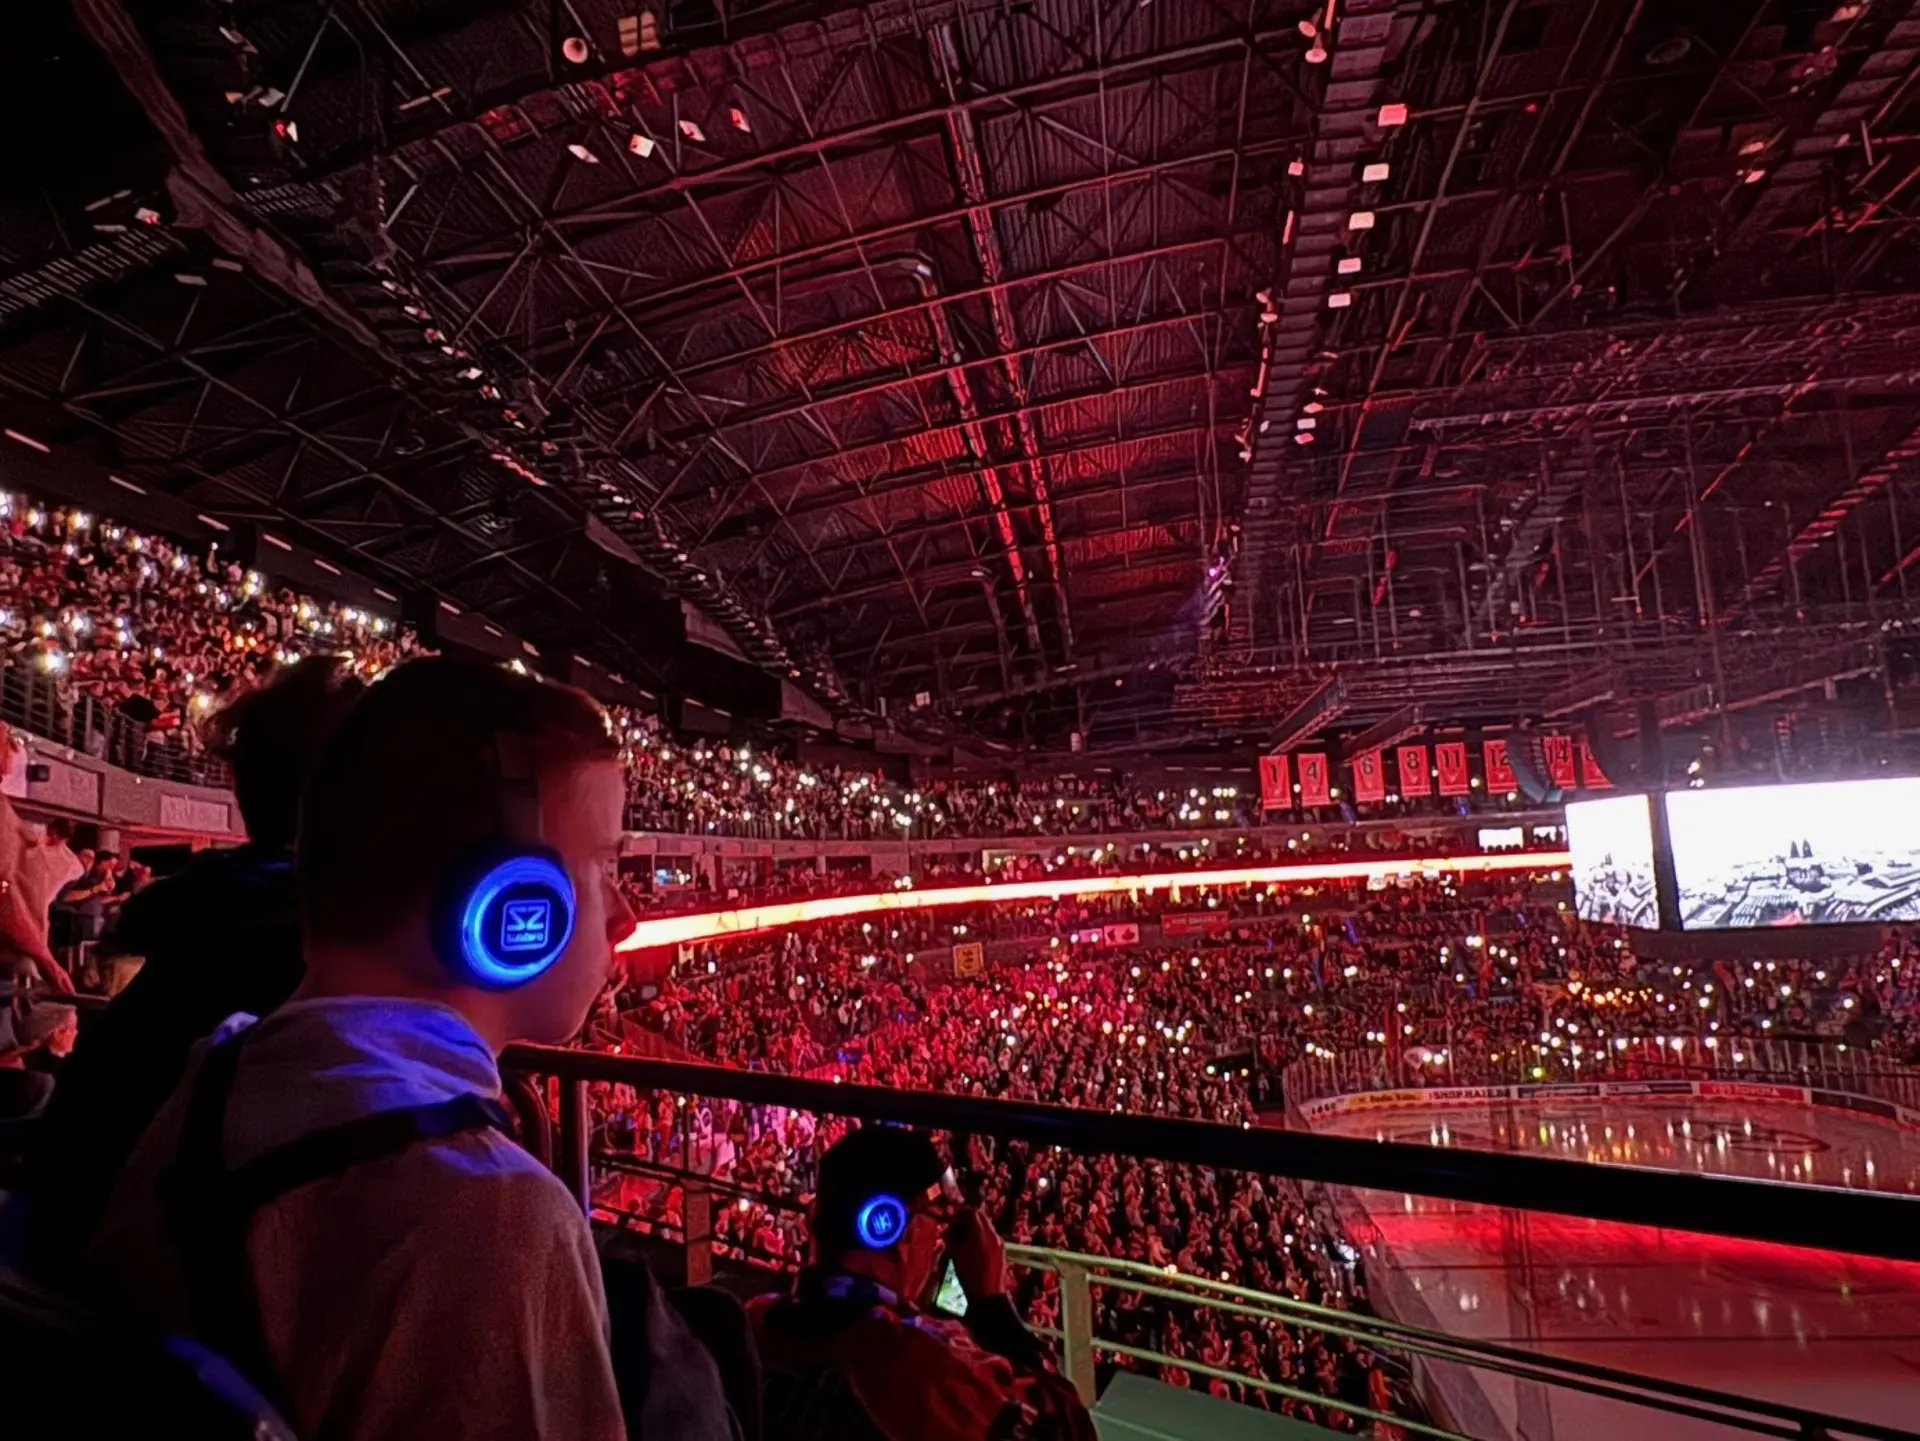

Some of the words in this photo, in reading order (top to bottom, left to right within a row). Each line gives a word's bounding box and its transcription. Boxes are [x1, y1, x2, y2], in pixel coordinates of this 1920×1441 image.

[1406, 750, 1420, 770] 8
[1442, 750, 1461, 769] 11
[1270, 763, 1279, 784] 1
[1306, 760, 1320, 781] 4
